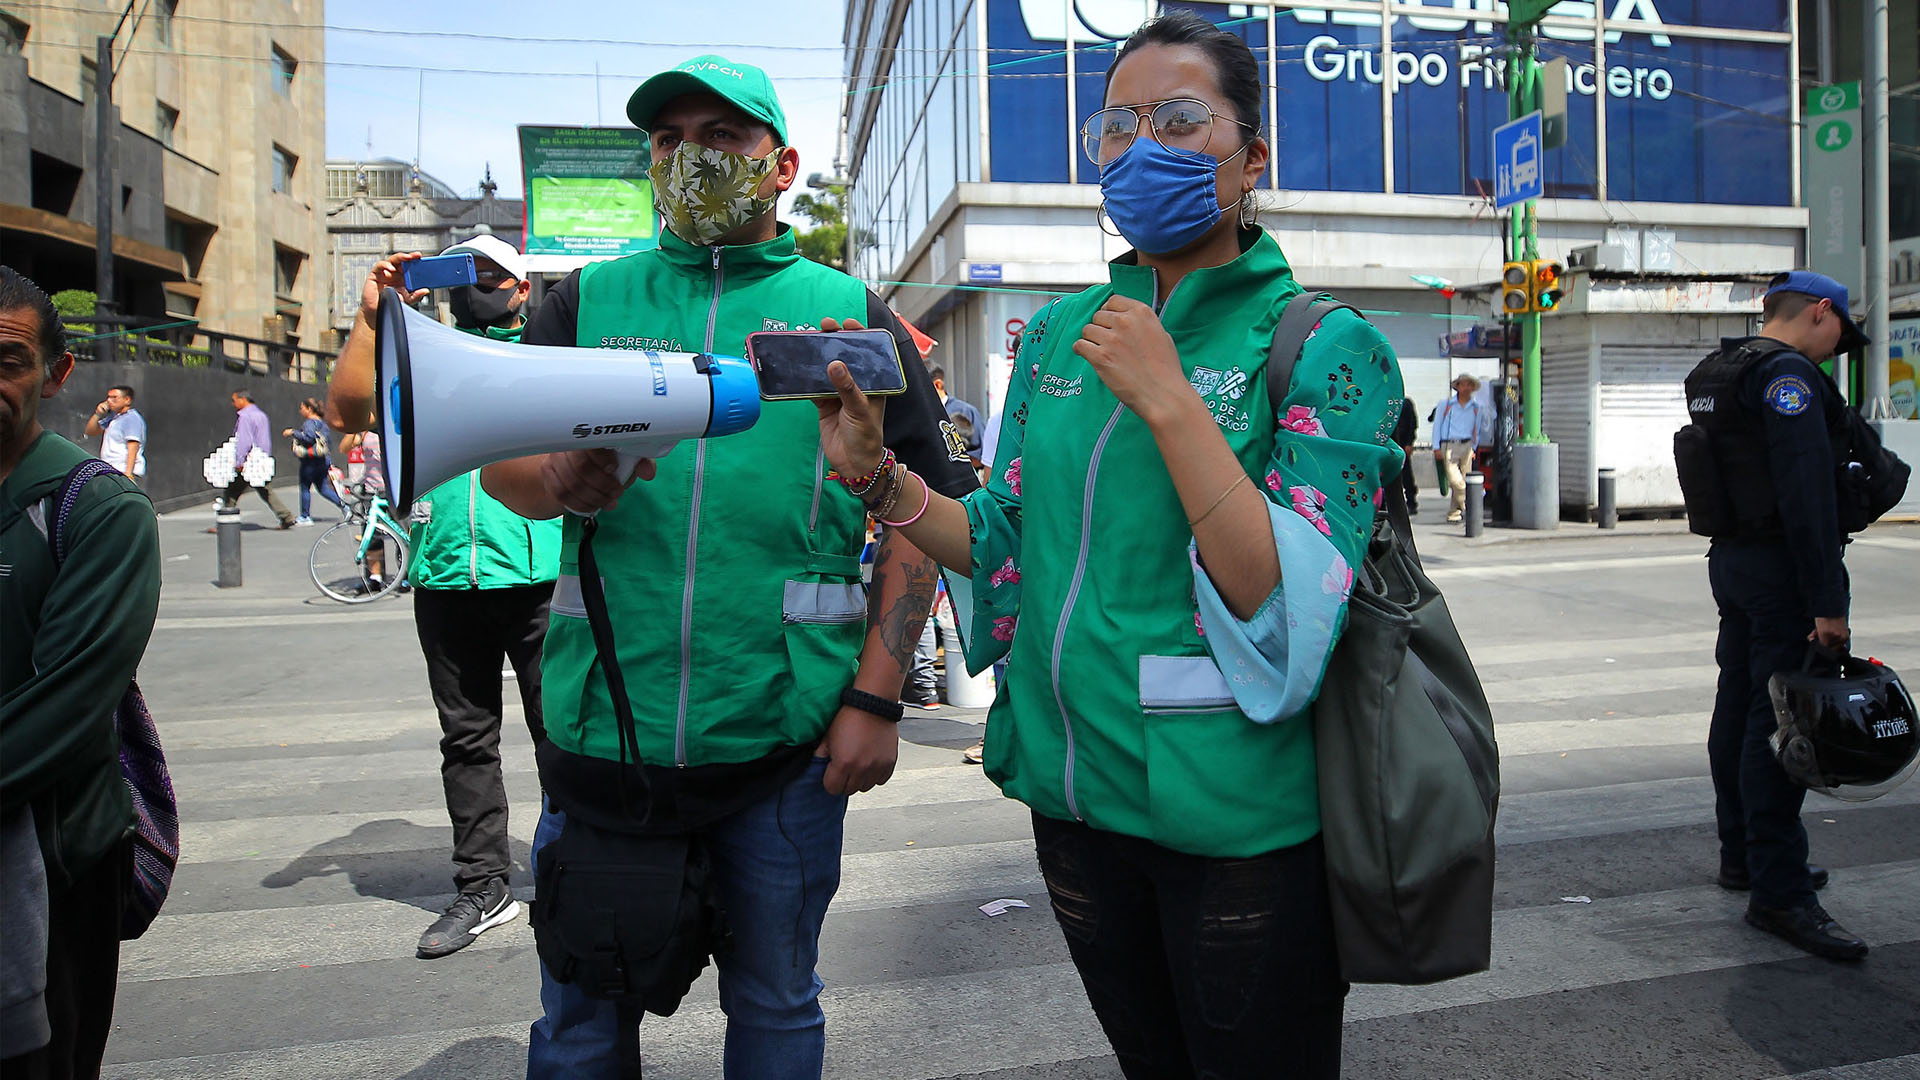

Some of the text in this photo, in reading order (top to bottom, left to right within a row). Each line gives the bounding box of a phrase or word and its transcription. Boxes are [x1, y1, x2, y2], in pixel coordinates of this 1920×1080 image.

[1304, 35, 1448, 94] Grupo
[578, 129, 621, 137] DISTANCIA
[1826, 185, 1844, 255] Madero
[601, 336, 683, 353] SECRETARÍA
[1219, 402, 1237, 416] DE
[593, 422, 651, 435] STEREN
